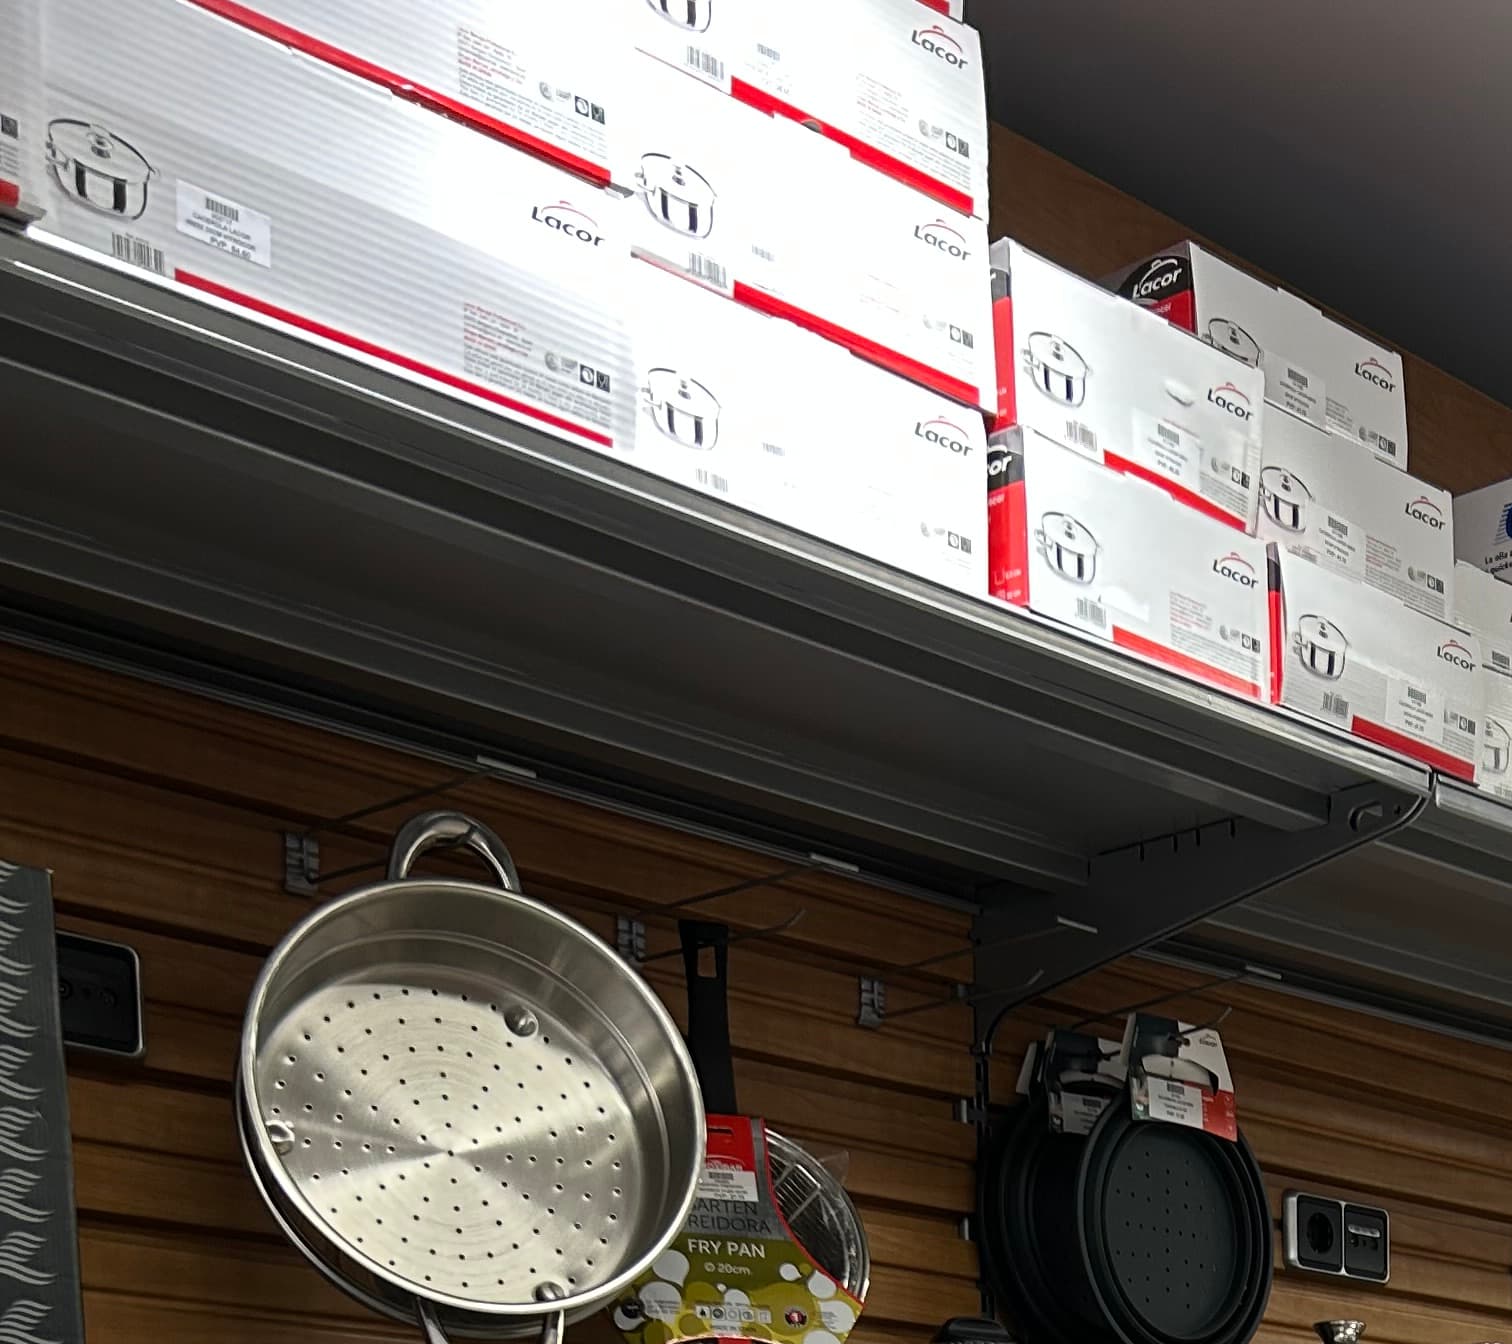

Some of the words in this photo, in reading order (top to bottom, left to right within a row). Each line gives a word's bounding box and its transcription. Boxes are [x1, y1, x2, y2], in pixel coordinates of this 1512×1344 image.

[911, 29, 968, 70] Lacor
[532, 206, 605, 248] Lacor
[913, 223, 971, 262] Lacor
[1131, 268, 1183, 302] Lacor
[1354, 361, 1397, 393] Lacor
[1207, 385, 1253, 421] Lacor
[914, 420, 973, 457] Lacor
[1405, 498, 1446, 532] Lacor
[1212, 557, 1260, 590] Lacor
[1436, 644, 1477, 673] Lacor
[688, 1214, 770, 1235] REIDORA
[693, 1200, 758, 1216] ARTEN
[687, 1238, 722, 1255] FRY
[727, 1241, 765, 1259] PAN
